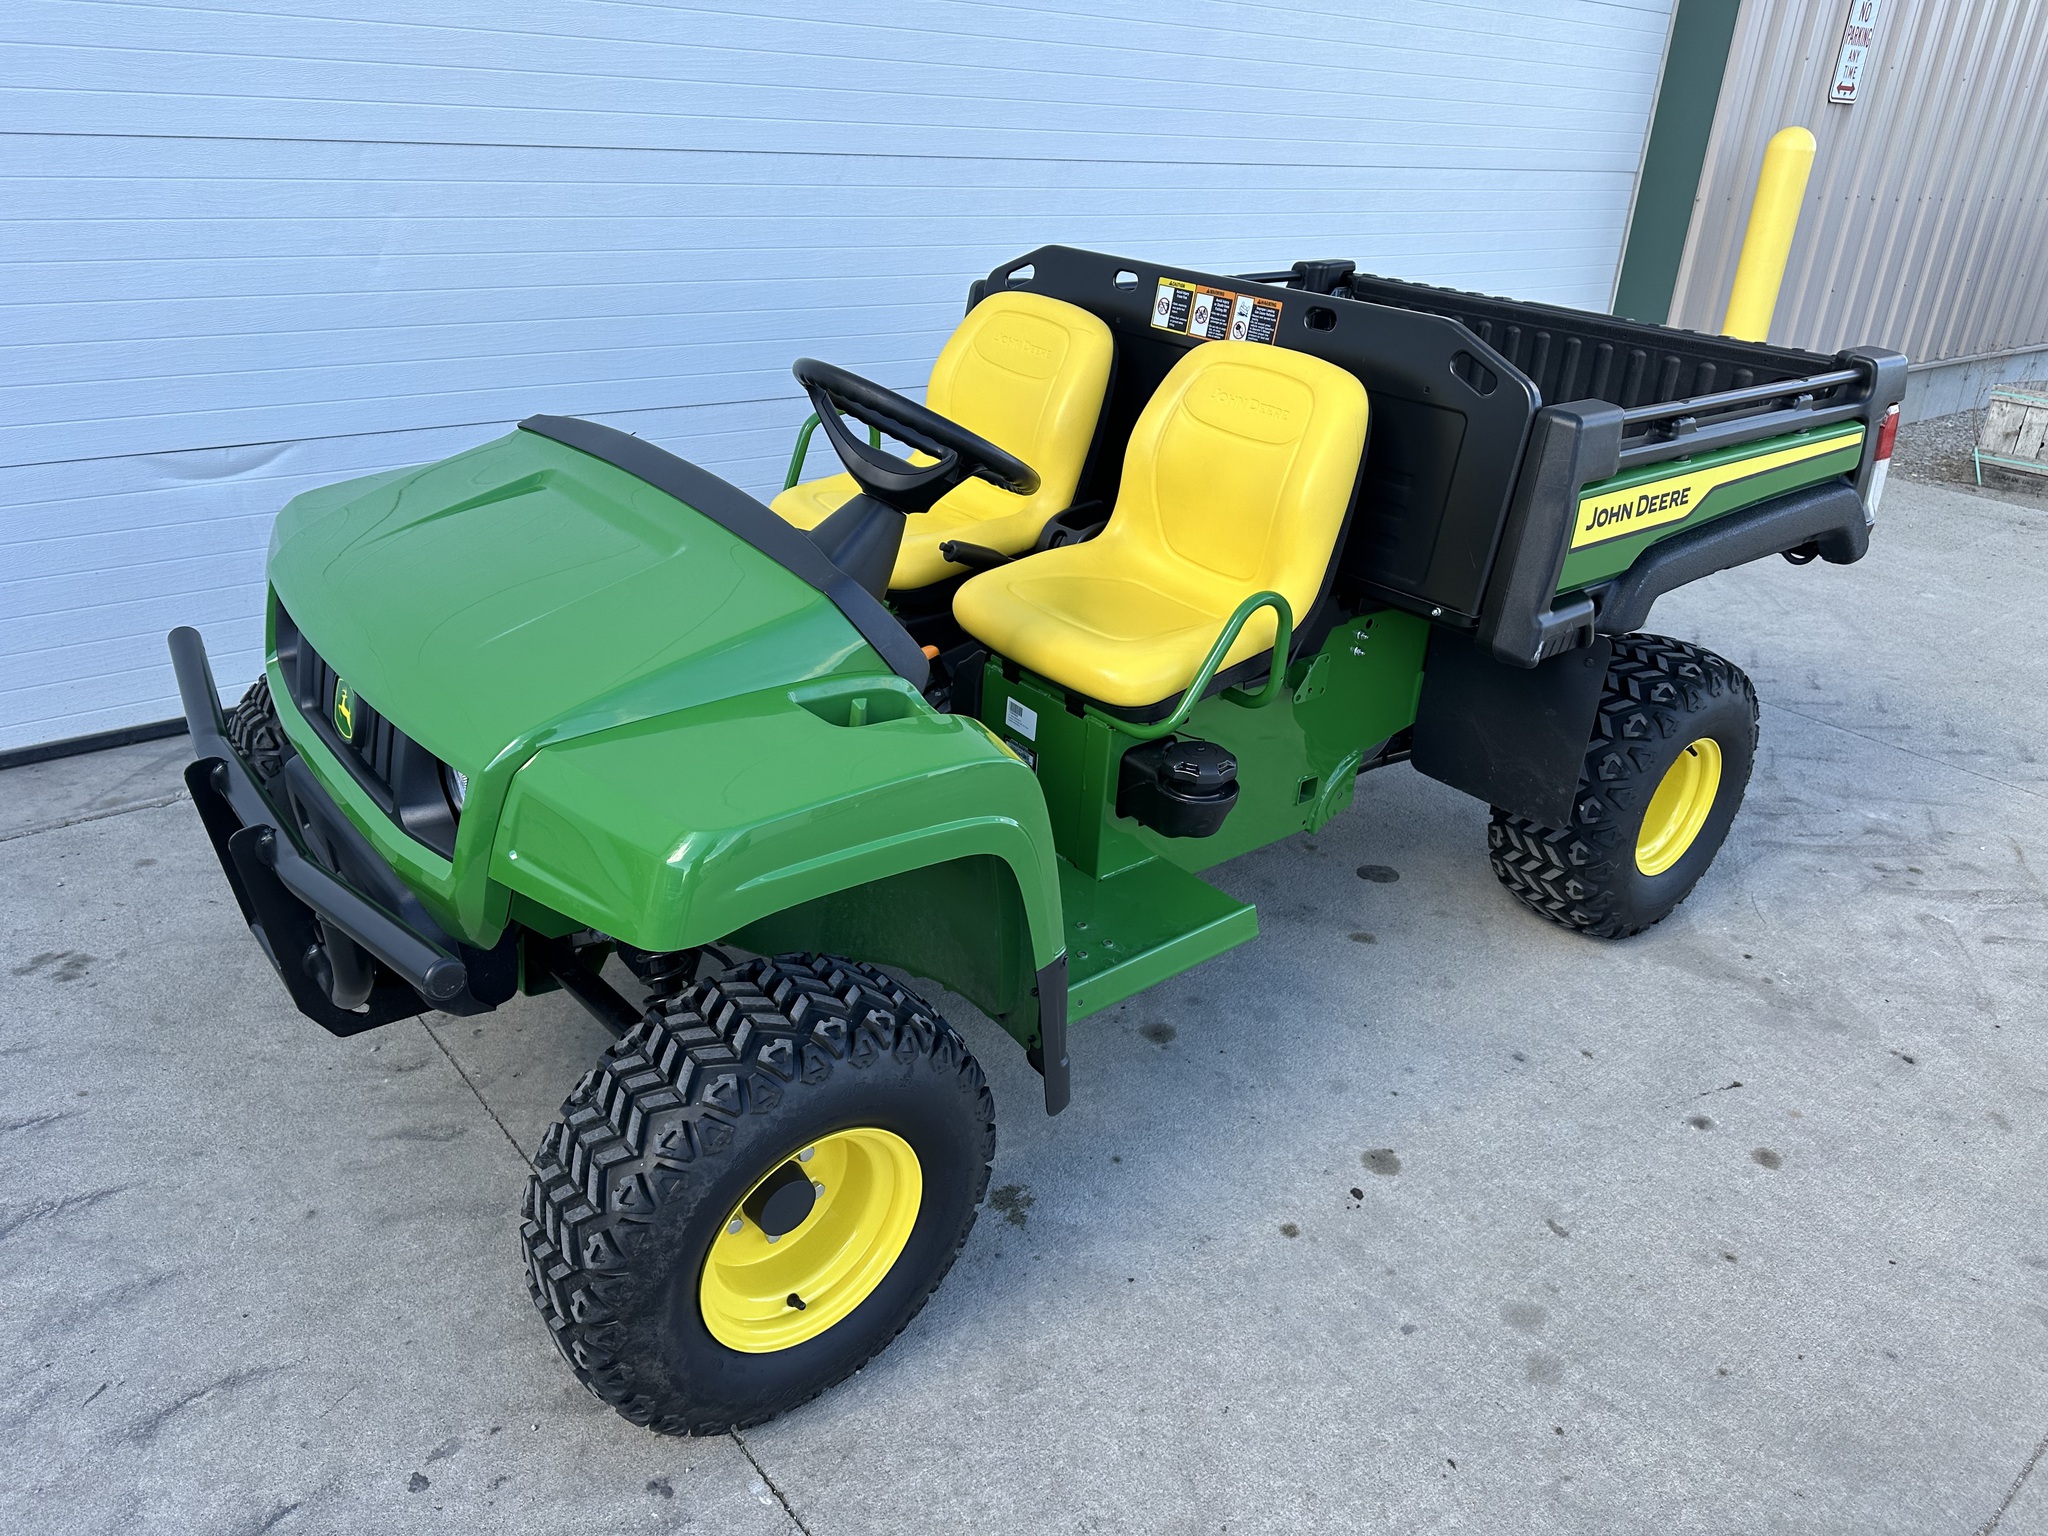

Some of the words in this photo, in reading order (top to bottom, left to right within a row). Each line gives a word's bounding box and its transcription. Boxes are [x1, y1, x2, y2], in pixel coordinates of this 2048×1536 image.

[1858, 1, 1873, 23] NO
[1843, 25, 1873, 48] PARKING
[1847, 49, 1861, 63] ANY
[1843, 65, 1858, 80] TIME
[1210, 387, 1249, 409] JOHN
[1248, 397, 1291, 422] DEERE
[1585, 500, 1634, 531] JOHN
[1635, 487, 1691, 517] DEERE
